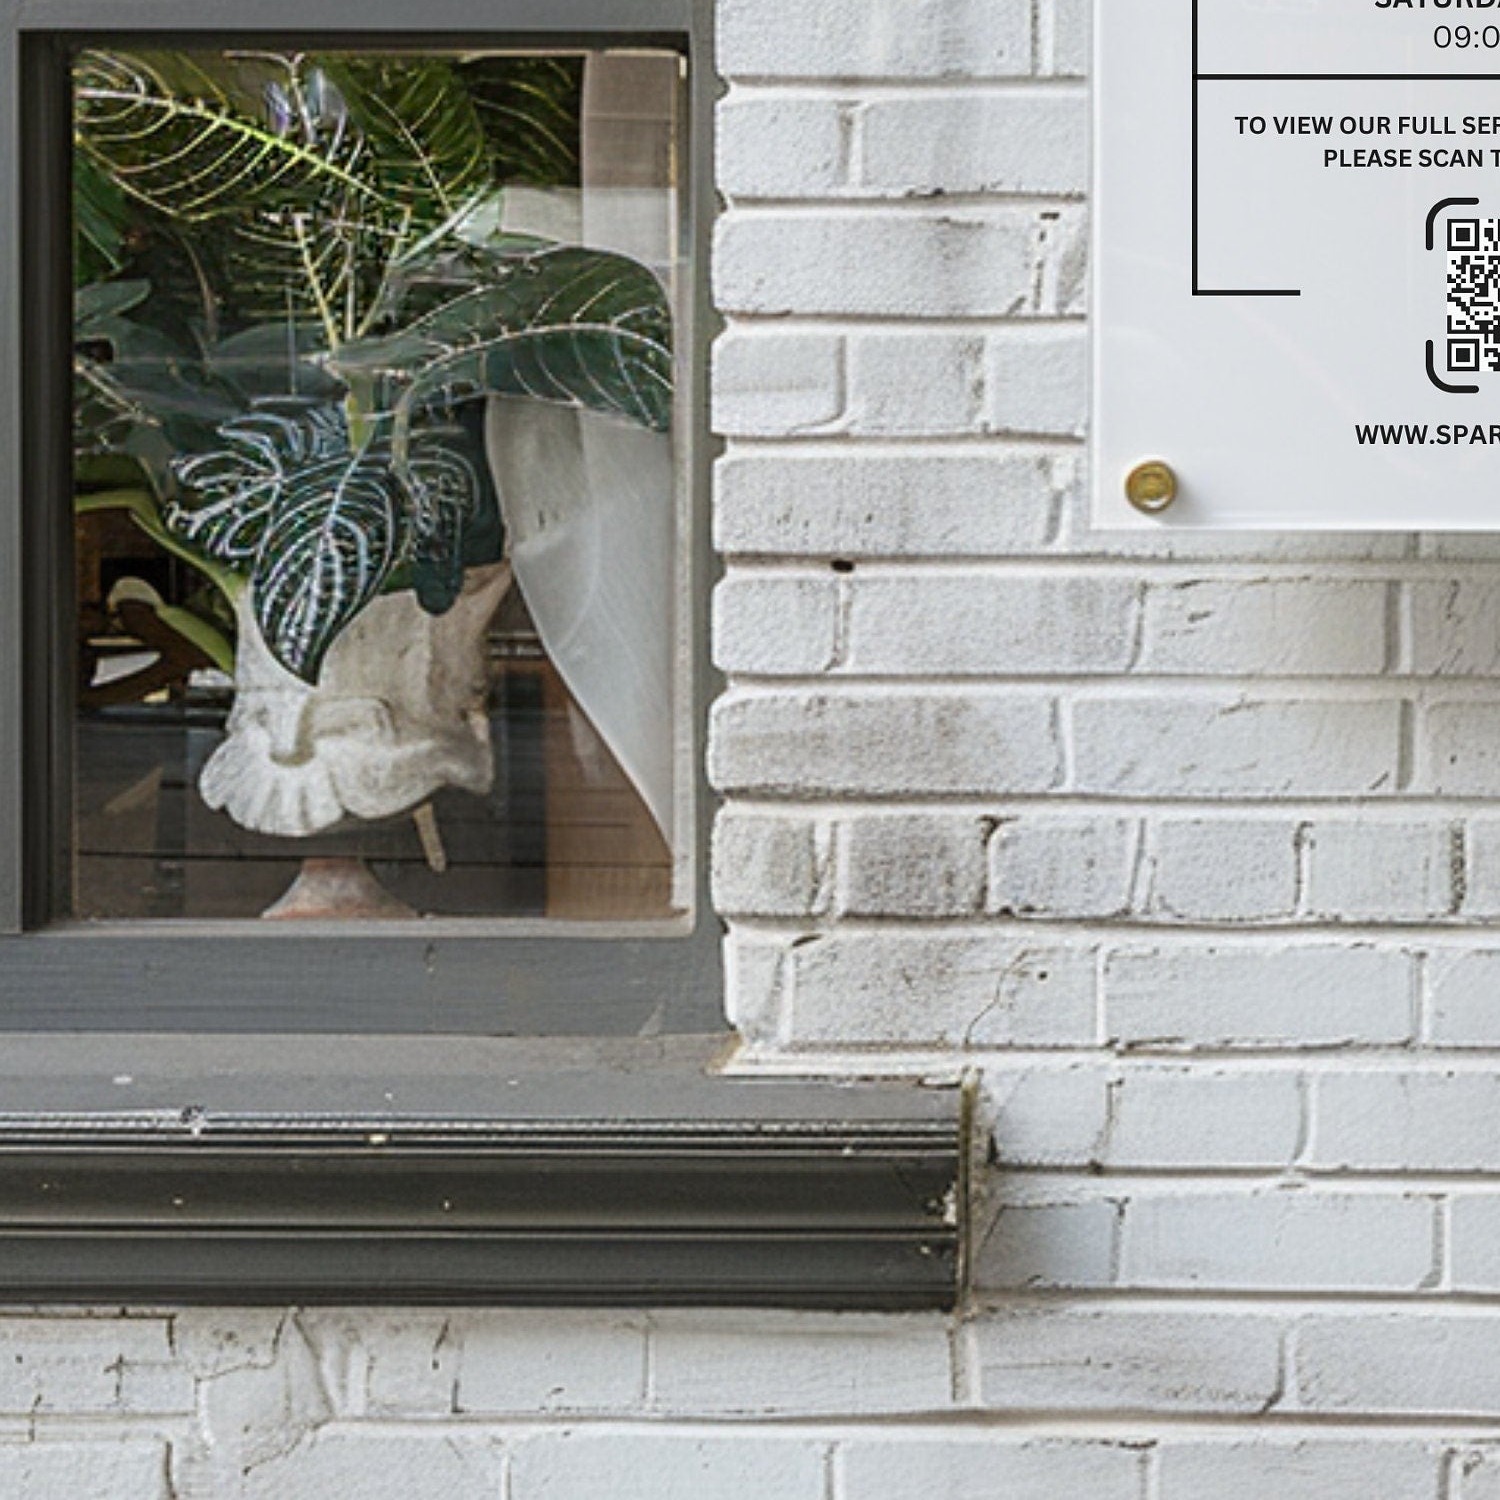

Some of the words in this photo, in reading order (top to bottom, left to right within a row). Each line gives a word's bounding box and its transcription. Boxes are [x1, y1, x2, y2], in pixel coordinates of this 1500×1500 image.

[1235, 117, 1266, 134] TO
[1273, 117, 1333, 134] VIEW
[1340, 117, 1390, 134] OUR
[1399, 117, 1456, 134] FULL
[1325, 149, 1411, 167] PLEASE
[1419, 150, 1482, 167] SCAN
